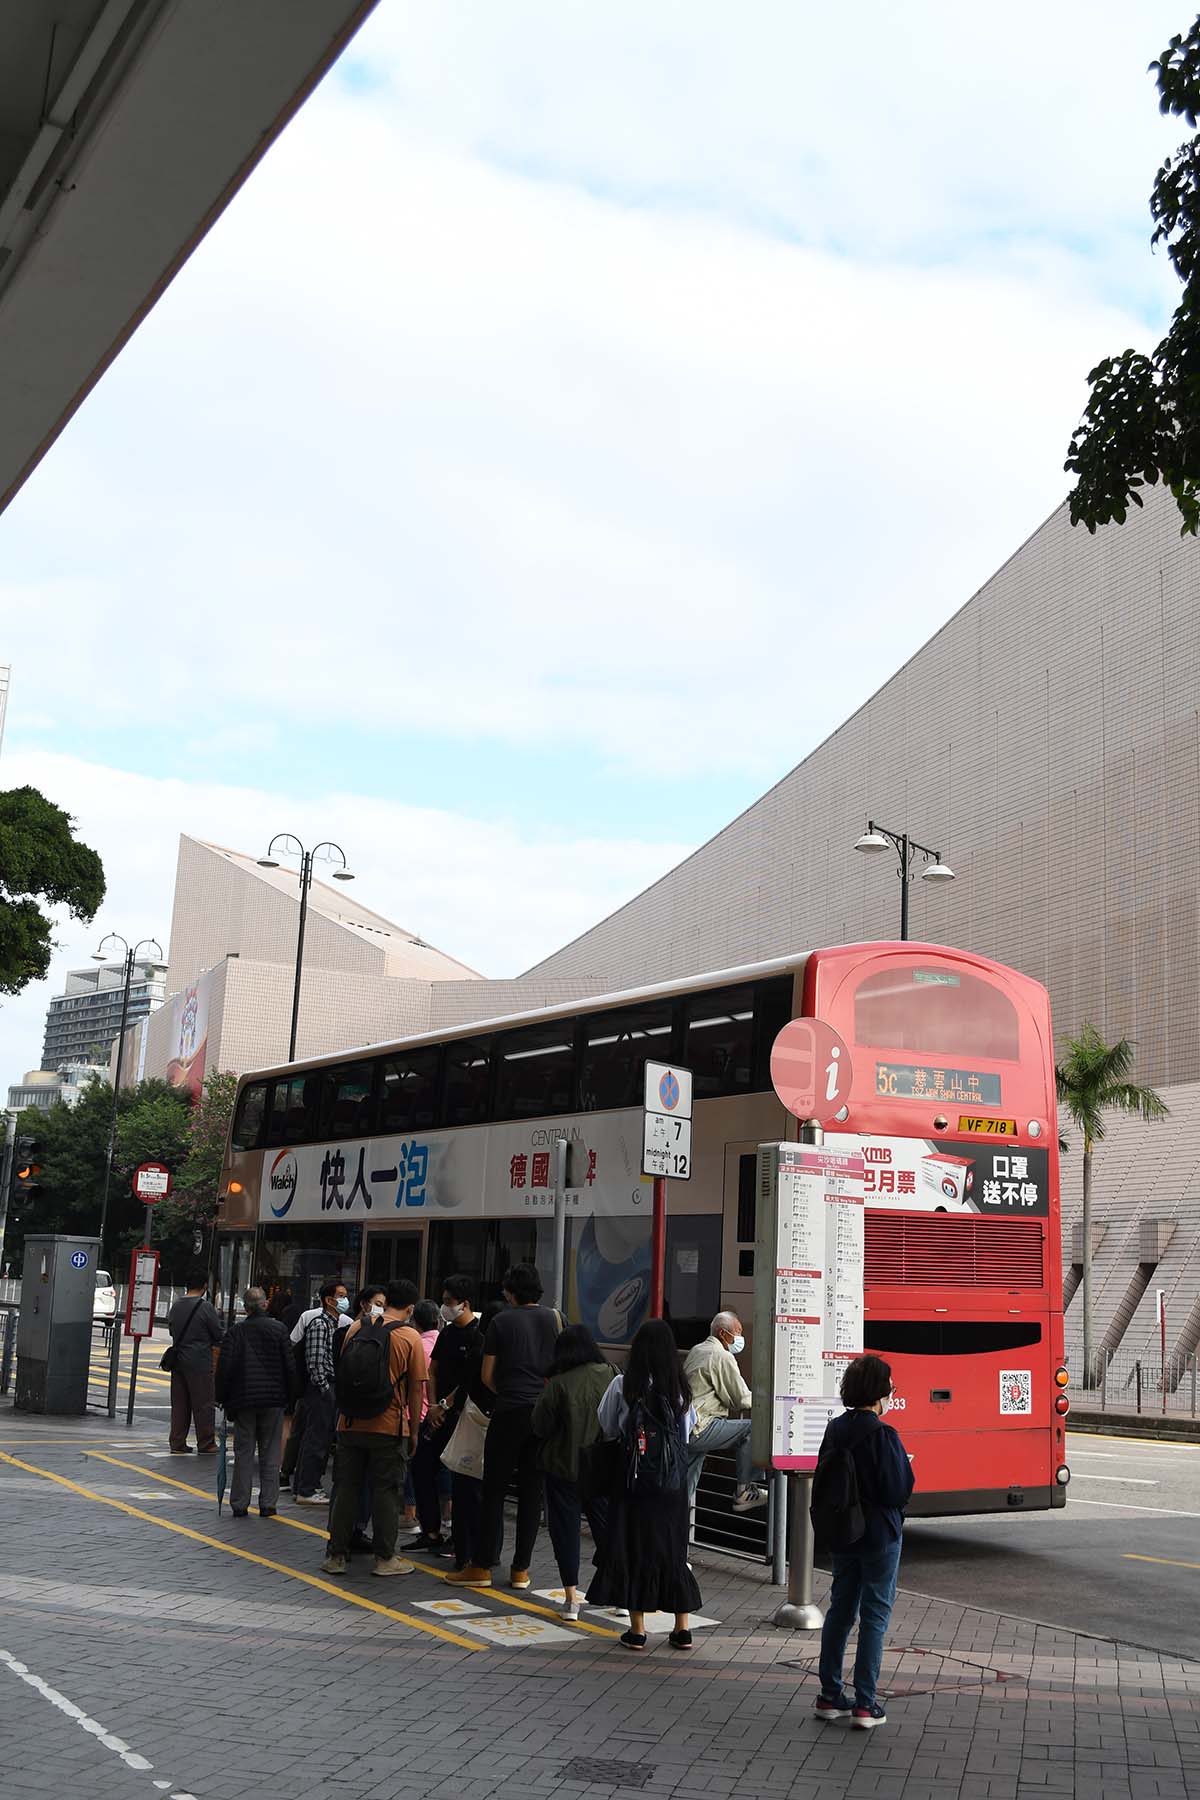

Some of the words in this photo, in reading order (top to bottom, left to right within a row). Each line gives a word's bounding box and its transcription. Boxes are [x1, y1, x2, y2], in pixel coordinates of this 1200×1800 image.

[674, 1122, 682, 1140] 7
[967, 1119, 983, 1131] VF
[987, 1121, 1007, 1133] 718
[646, 1148, 671, 1160] midnight
[673, 1155, 687, 1174] 12
[993, 1156, 1028, 1179] 口罩
[271, 1173, 294, 1190] Walch
[319, 1140, 429, 1211] 快人一泡
[983, 1180, 1038, 1206] 送不停
